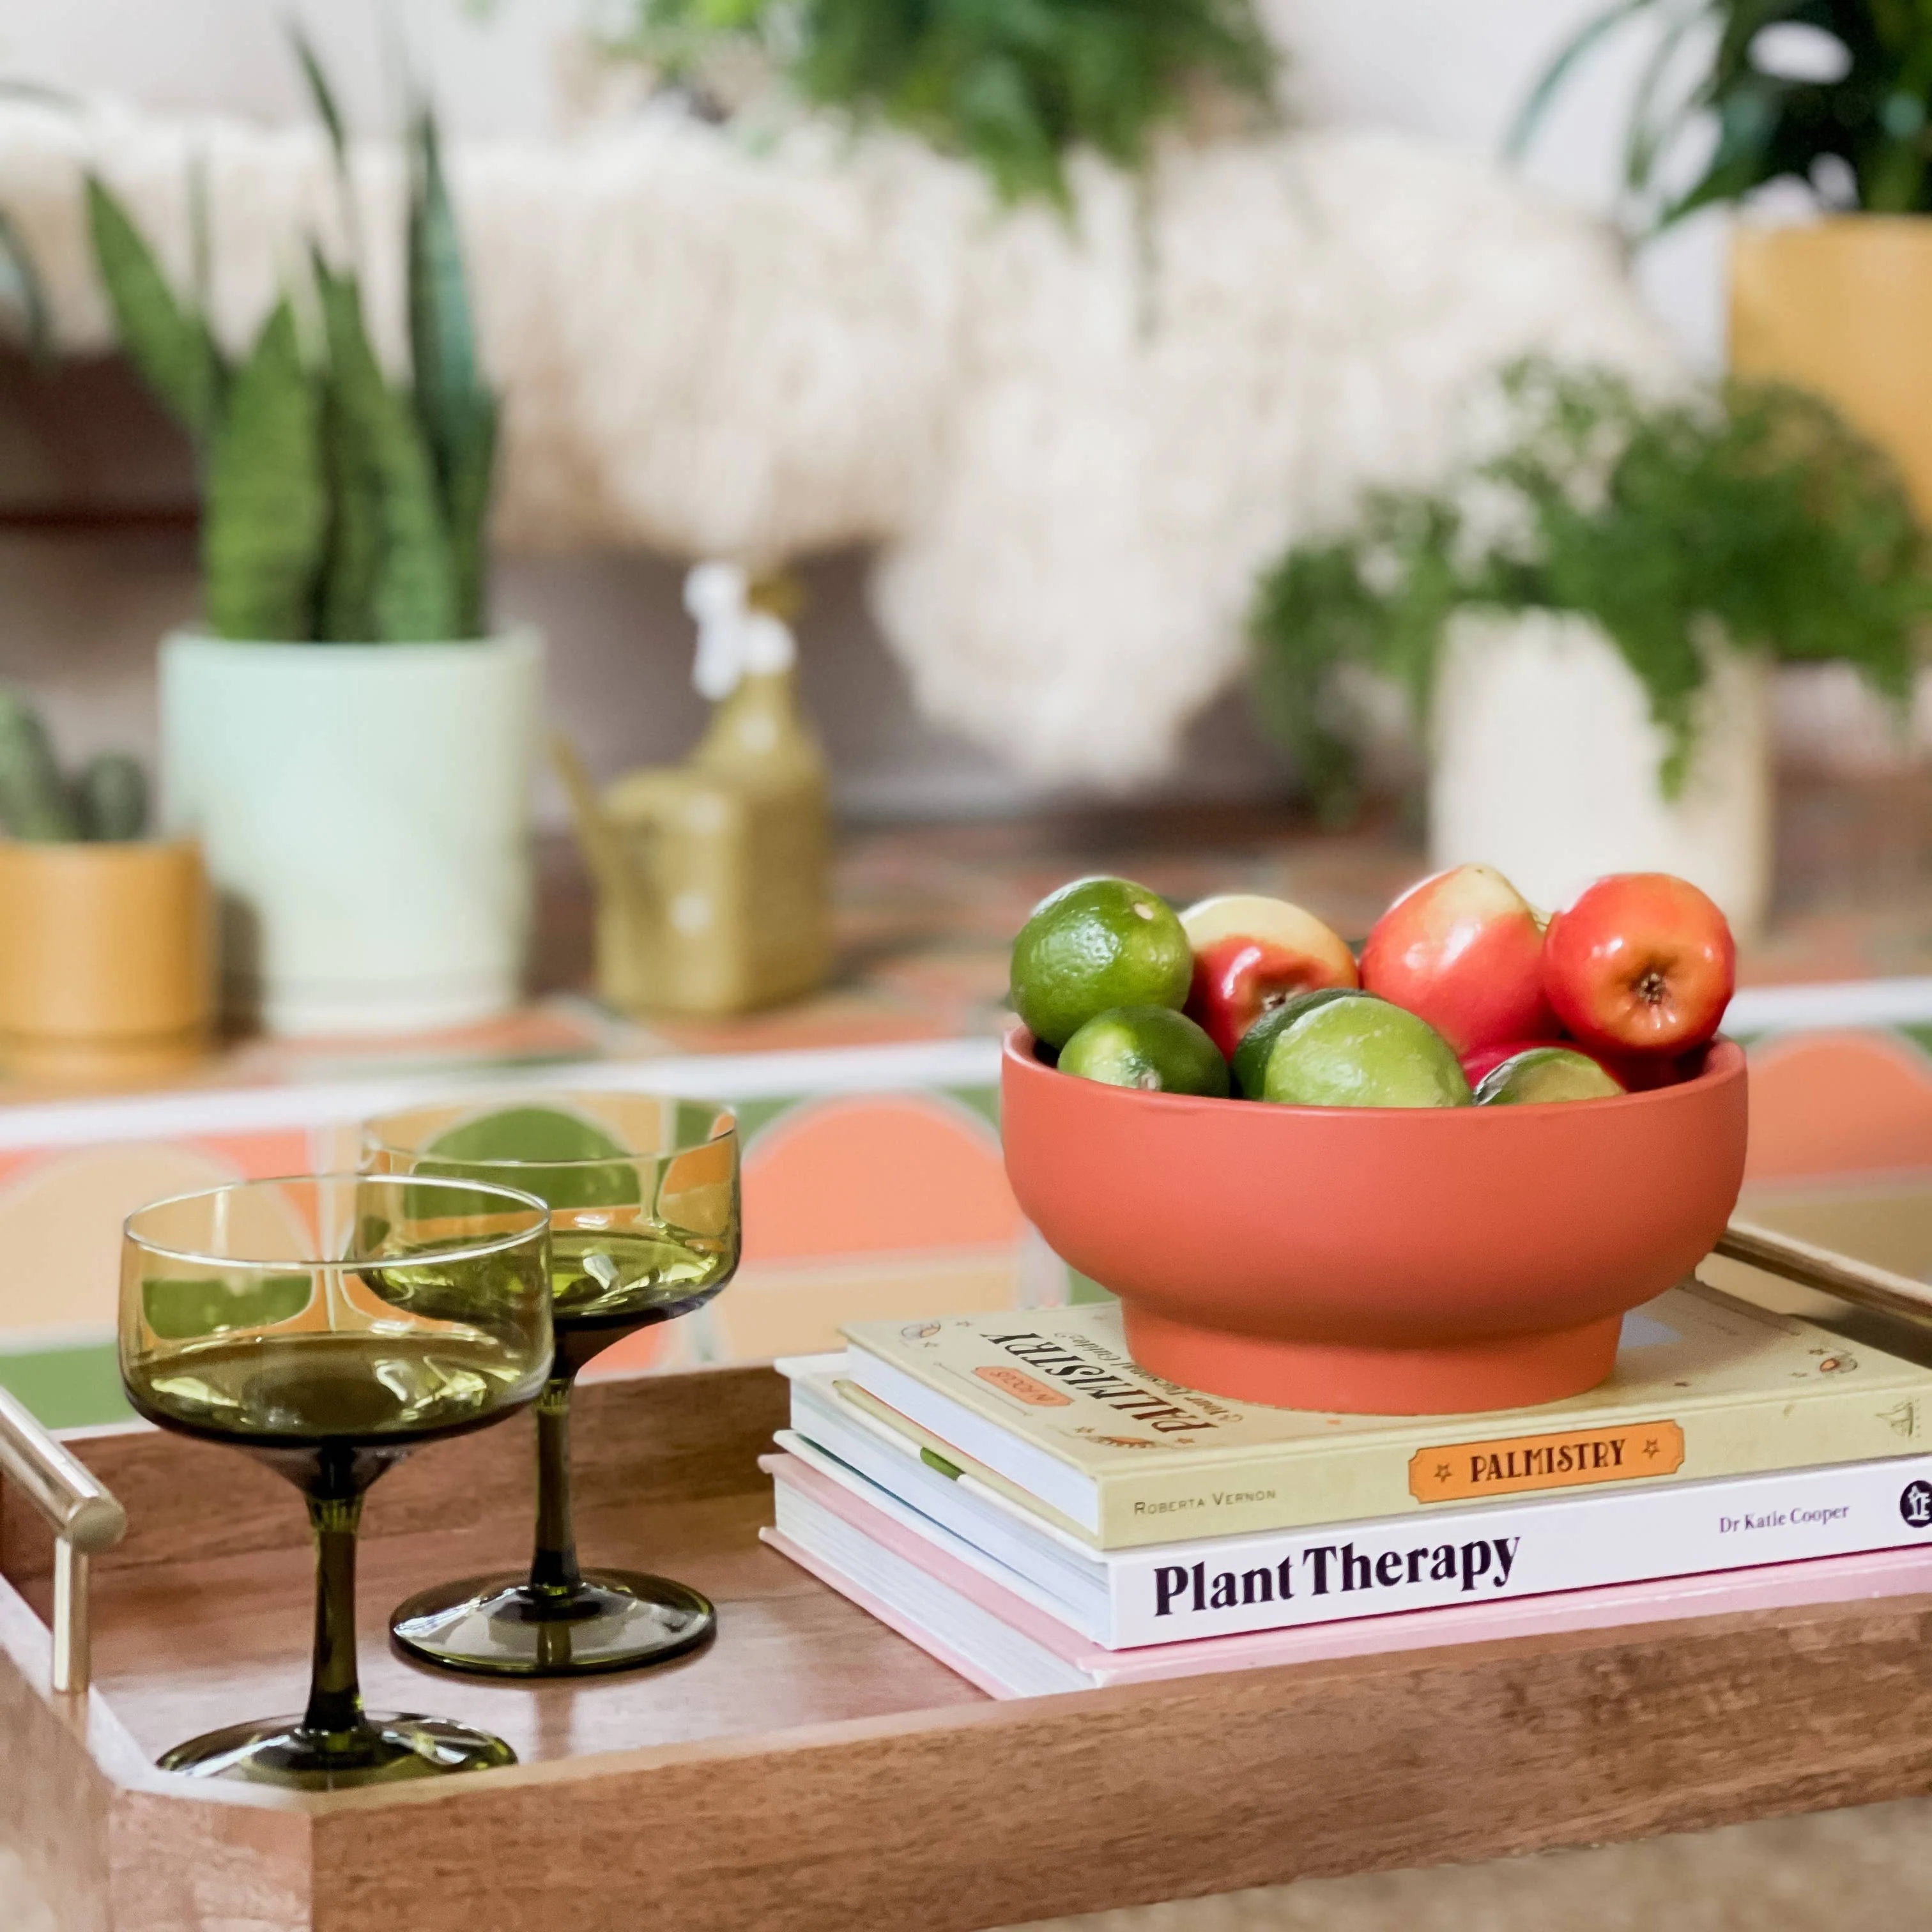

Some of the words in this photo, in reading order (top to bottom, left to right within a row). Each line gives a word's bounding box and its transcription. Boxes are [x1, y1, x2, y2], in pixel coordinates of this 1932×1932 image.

[979, 1333, 1219, 1434] PALMISTRY
[1471, 1439, 1627, 1483] PALMISTRY
[1719, 1516, 1741, 1534] Dr
[1744, 1510, 1786, 1530] Katie
[1790, 1505, 1850, 1525] Cooper
[1153, 1555, 1294, 1616] Plant
[1303, 1536, 1521, 1595] Therapy
